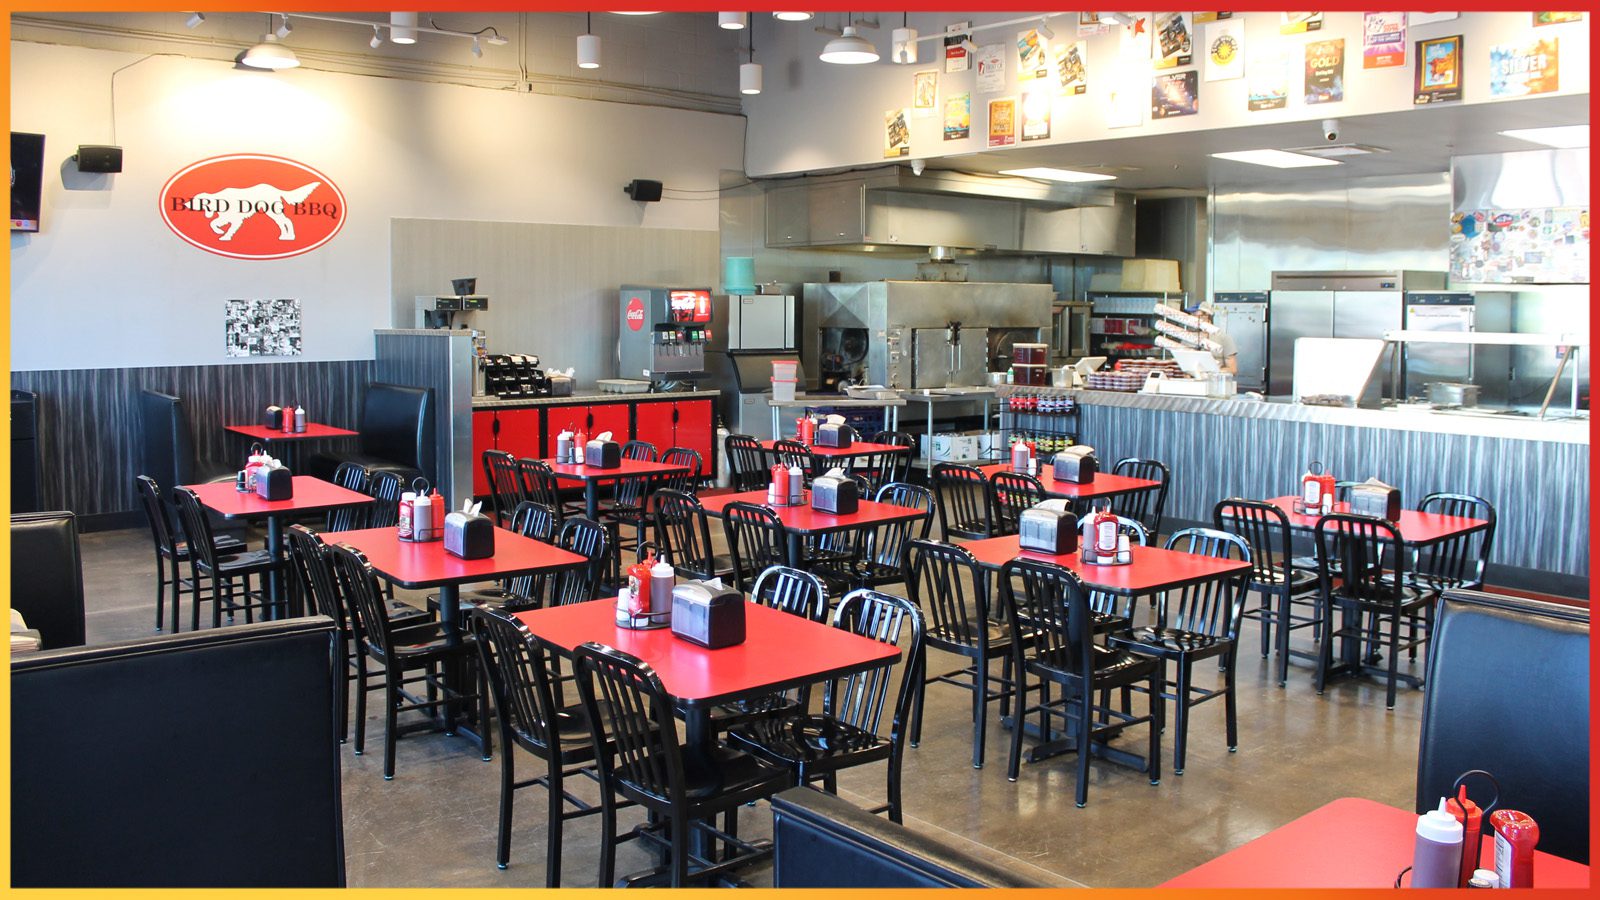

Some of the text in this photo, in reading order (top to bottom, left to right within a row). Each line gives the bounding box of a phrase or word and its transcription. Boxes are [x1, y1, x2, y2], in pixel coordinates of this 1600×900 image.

[1310, 56, 1340, 69] GOLD
[1502, 54, 1546, 75] SILVER
[172, 197, 337, 219] BIRD DOG BBQ
